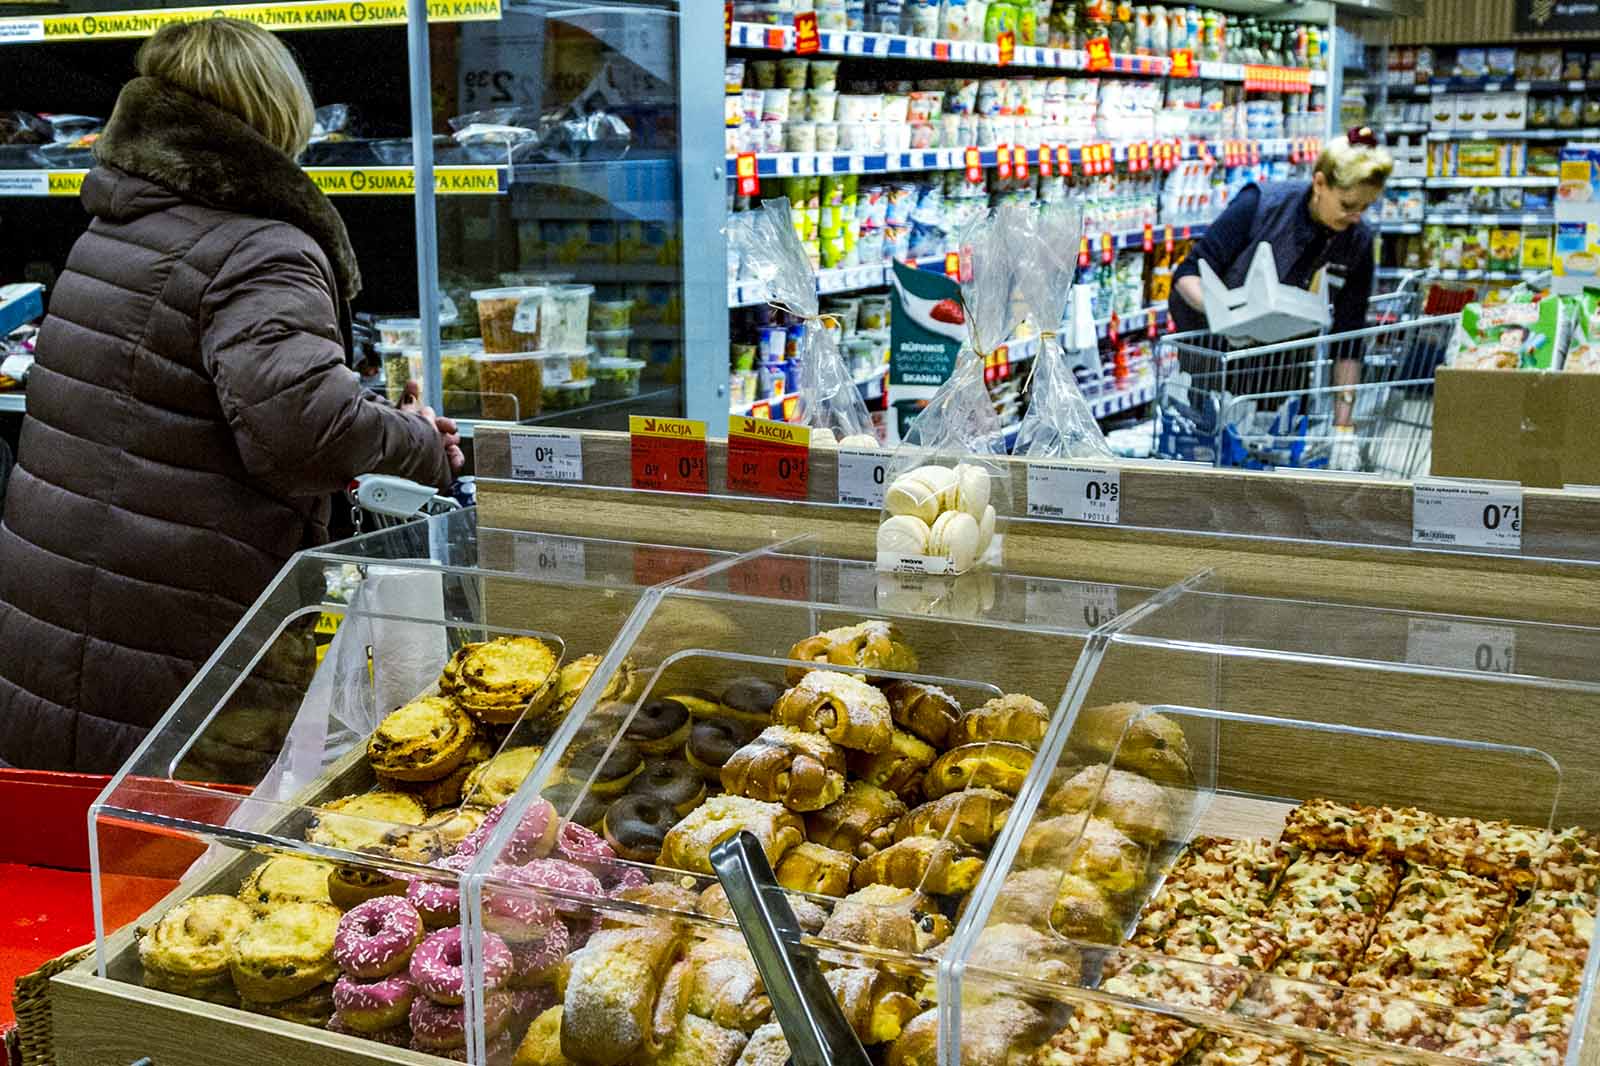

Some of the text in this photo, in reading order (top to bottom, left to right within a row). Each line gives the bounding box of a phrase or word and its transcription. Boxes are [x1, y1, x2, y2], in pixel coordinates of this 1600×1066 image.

[43, 19, 79, 35] KAINA
[305, 9, 344, 23] KAINA
[453, 0, 498, 16] KAINA
[452, 175, 495, 188] KAINA
[902, 373, 942, 383] SKANIAI
[657, 423, 692, 435] AKCIJA
[757, 425, 794, 441] AKCIJA
